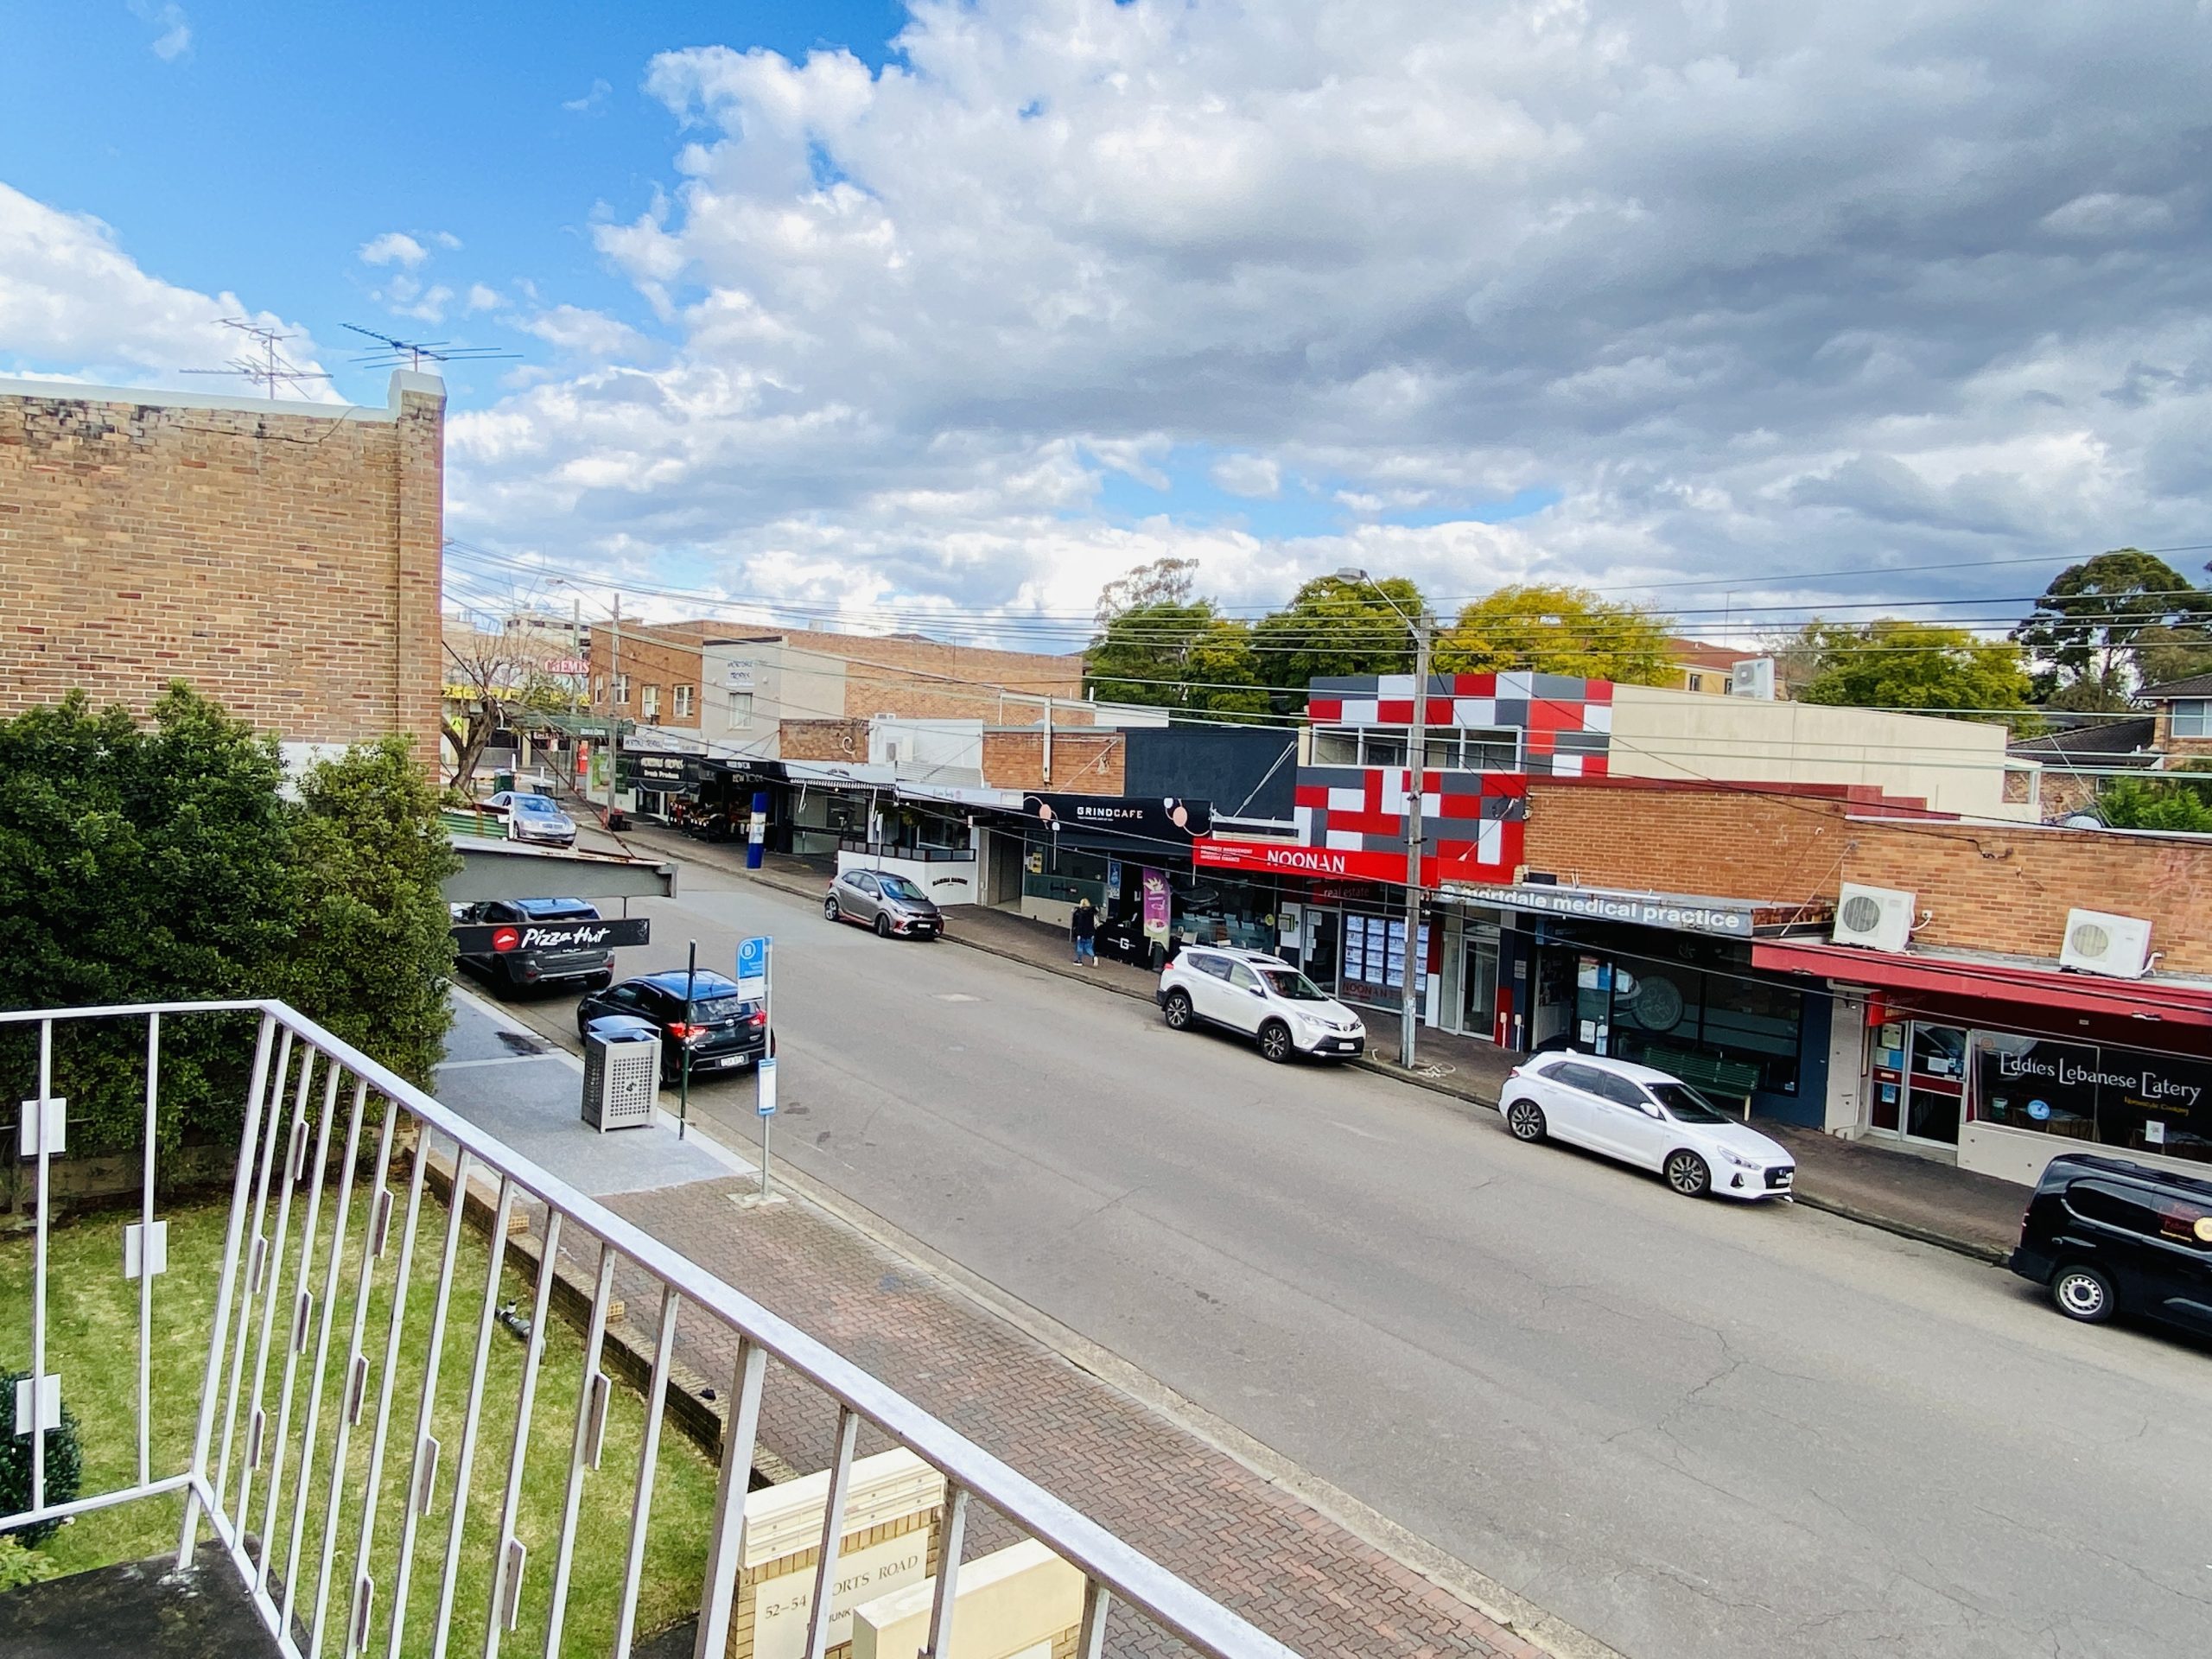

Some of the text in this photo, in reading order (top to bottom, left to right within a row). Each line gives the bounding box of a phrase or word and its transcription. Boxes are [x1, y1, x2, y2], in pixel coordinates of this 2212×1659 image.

[1267, 849, 1345, 873] NOONAN
[1553, 899, 1637, 918] medical
[1643, 906, 1739, 928] practice
[521, 926, 611, 949] Pizza Hut
[2059, 1058, 2137, 1089] Lebanese
[2141, 1071, 2202, 1106] Eatery
[765, 1555, 918, 1619] 52-54 ORTS ROAD
